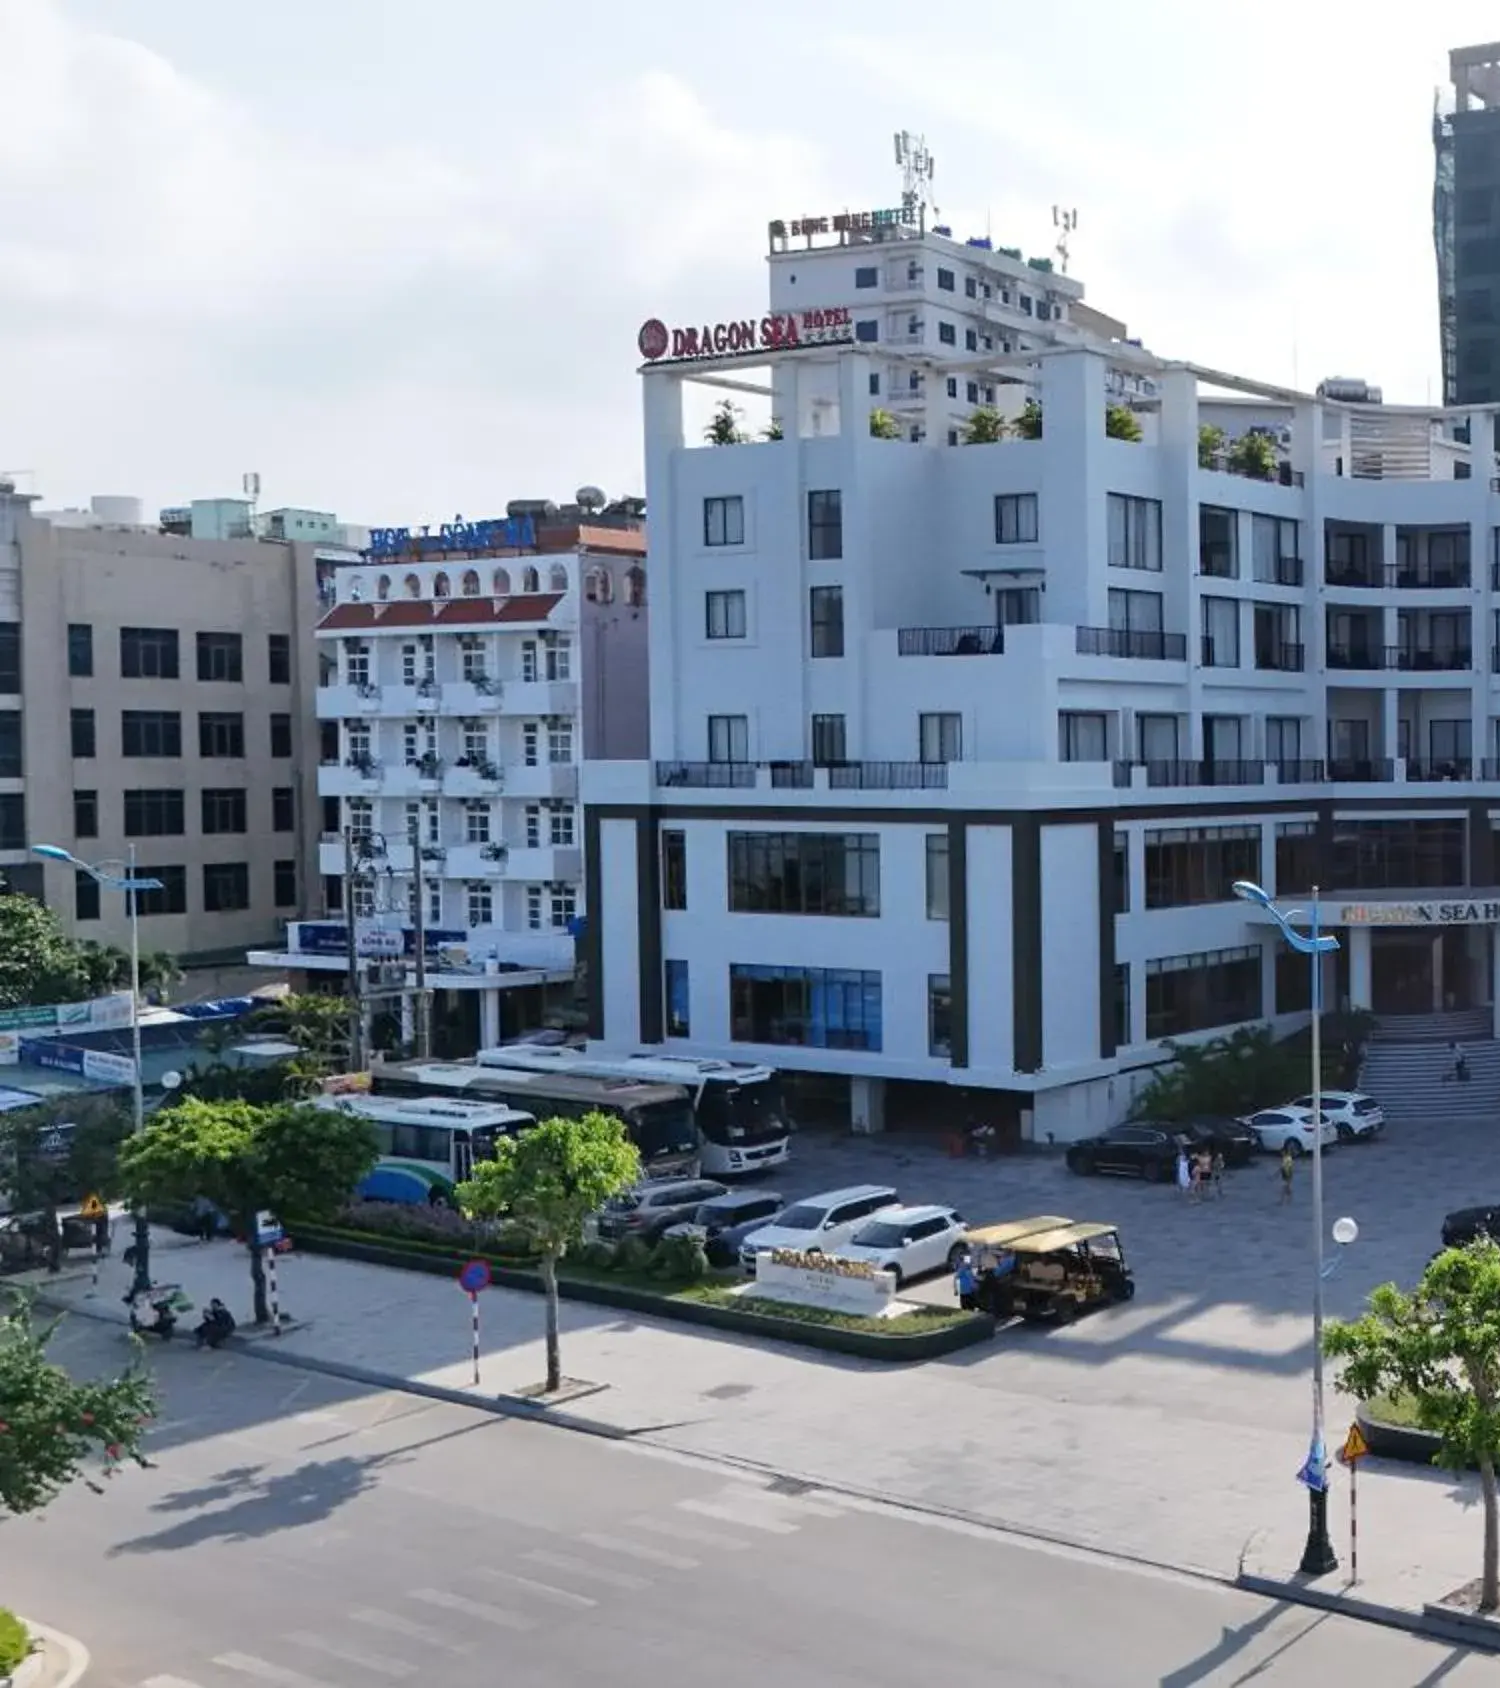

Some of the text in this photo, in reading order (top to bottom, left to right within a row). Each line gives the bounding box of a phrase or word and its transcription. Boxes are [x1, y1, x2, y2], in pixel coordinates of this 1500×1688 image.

[672, 307, 851, 356] DRAGON SEA HOTEL
[1440, 904, 1479, 920] SEA
